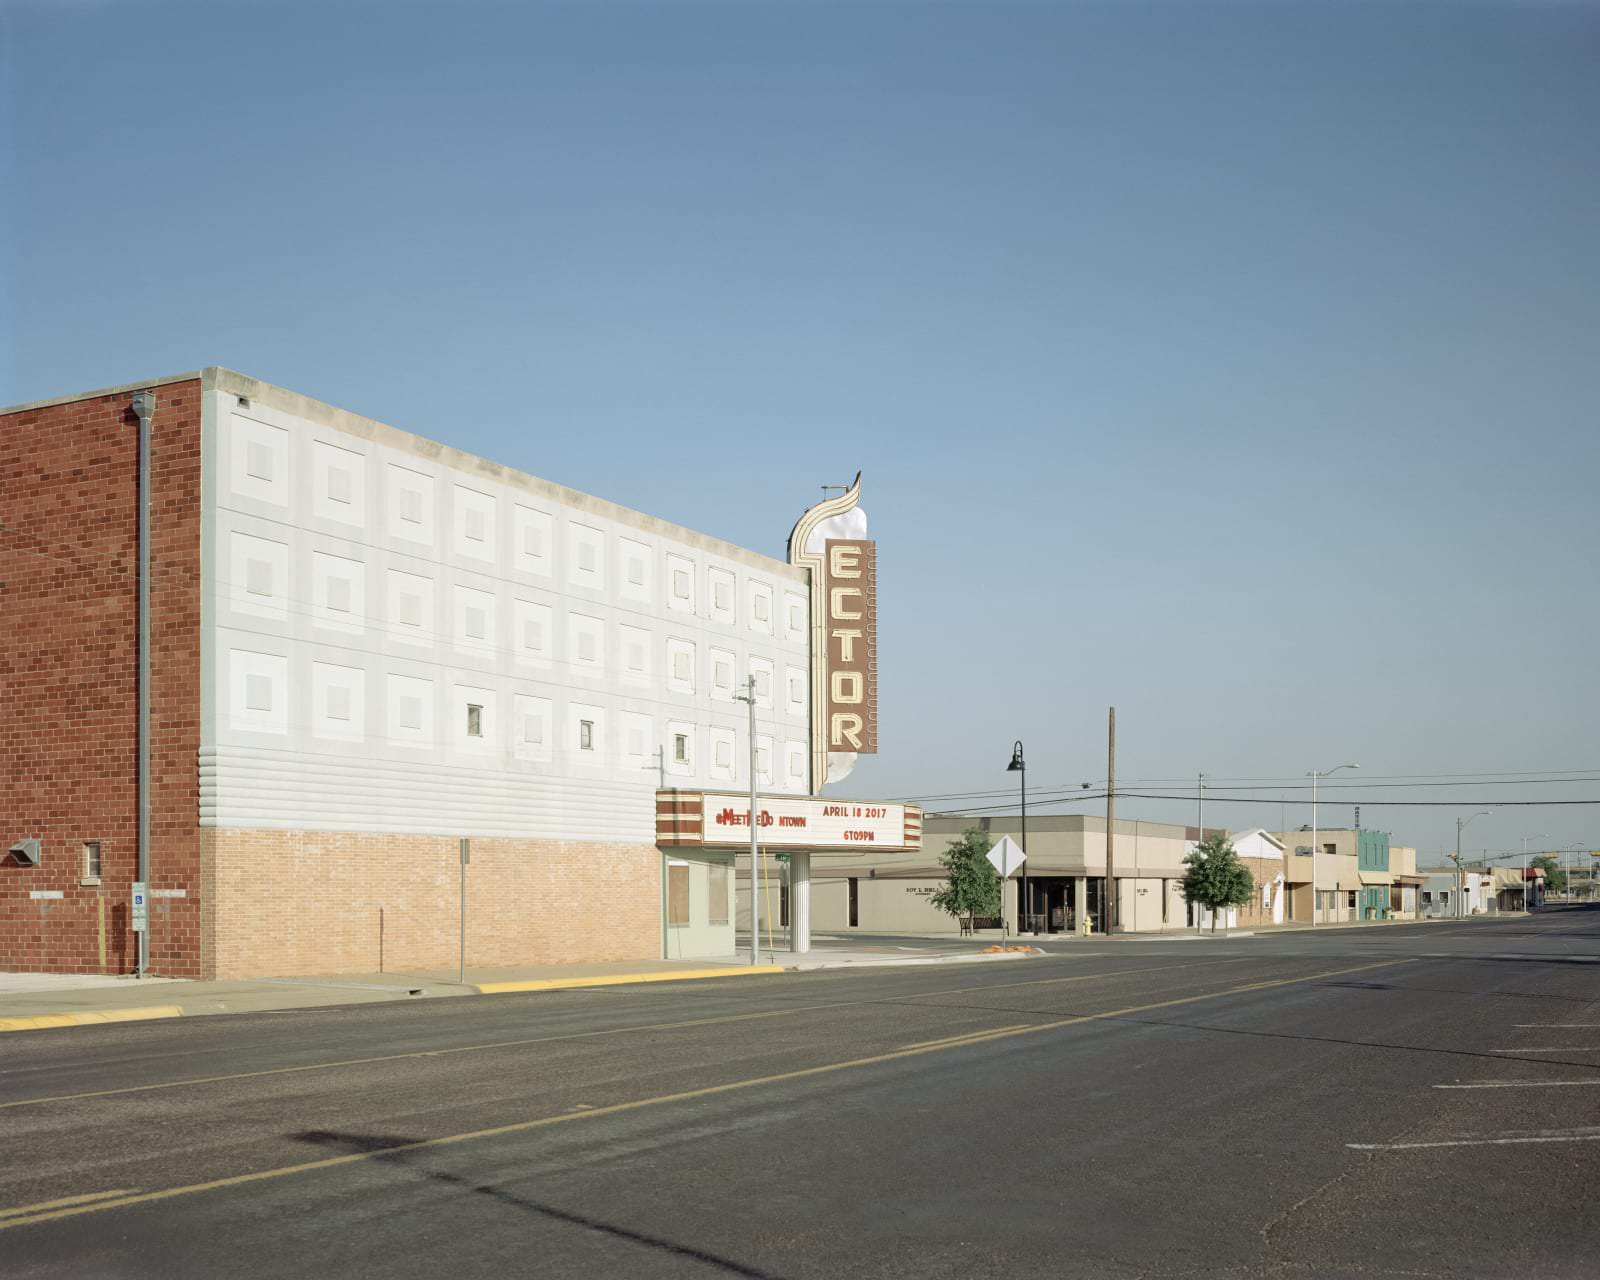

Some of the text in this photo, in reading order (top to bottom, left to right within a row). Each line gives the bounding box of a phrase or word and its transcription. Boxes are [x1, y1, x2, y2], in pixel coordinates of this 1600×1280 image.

[829, 544, 864, 751] ECTOR
[823, 805, 887, 819] APRIL 18 2017
